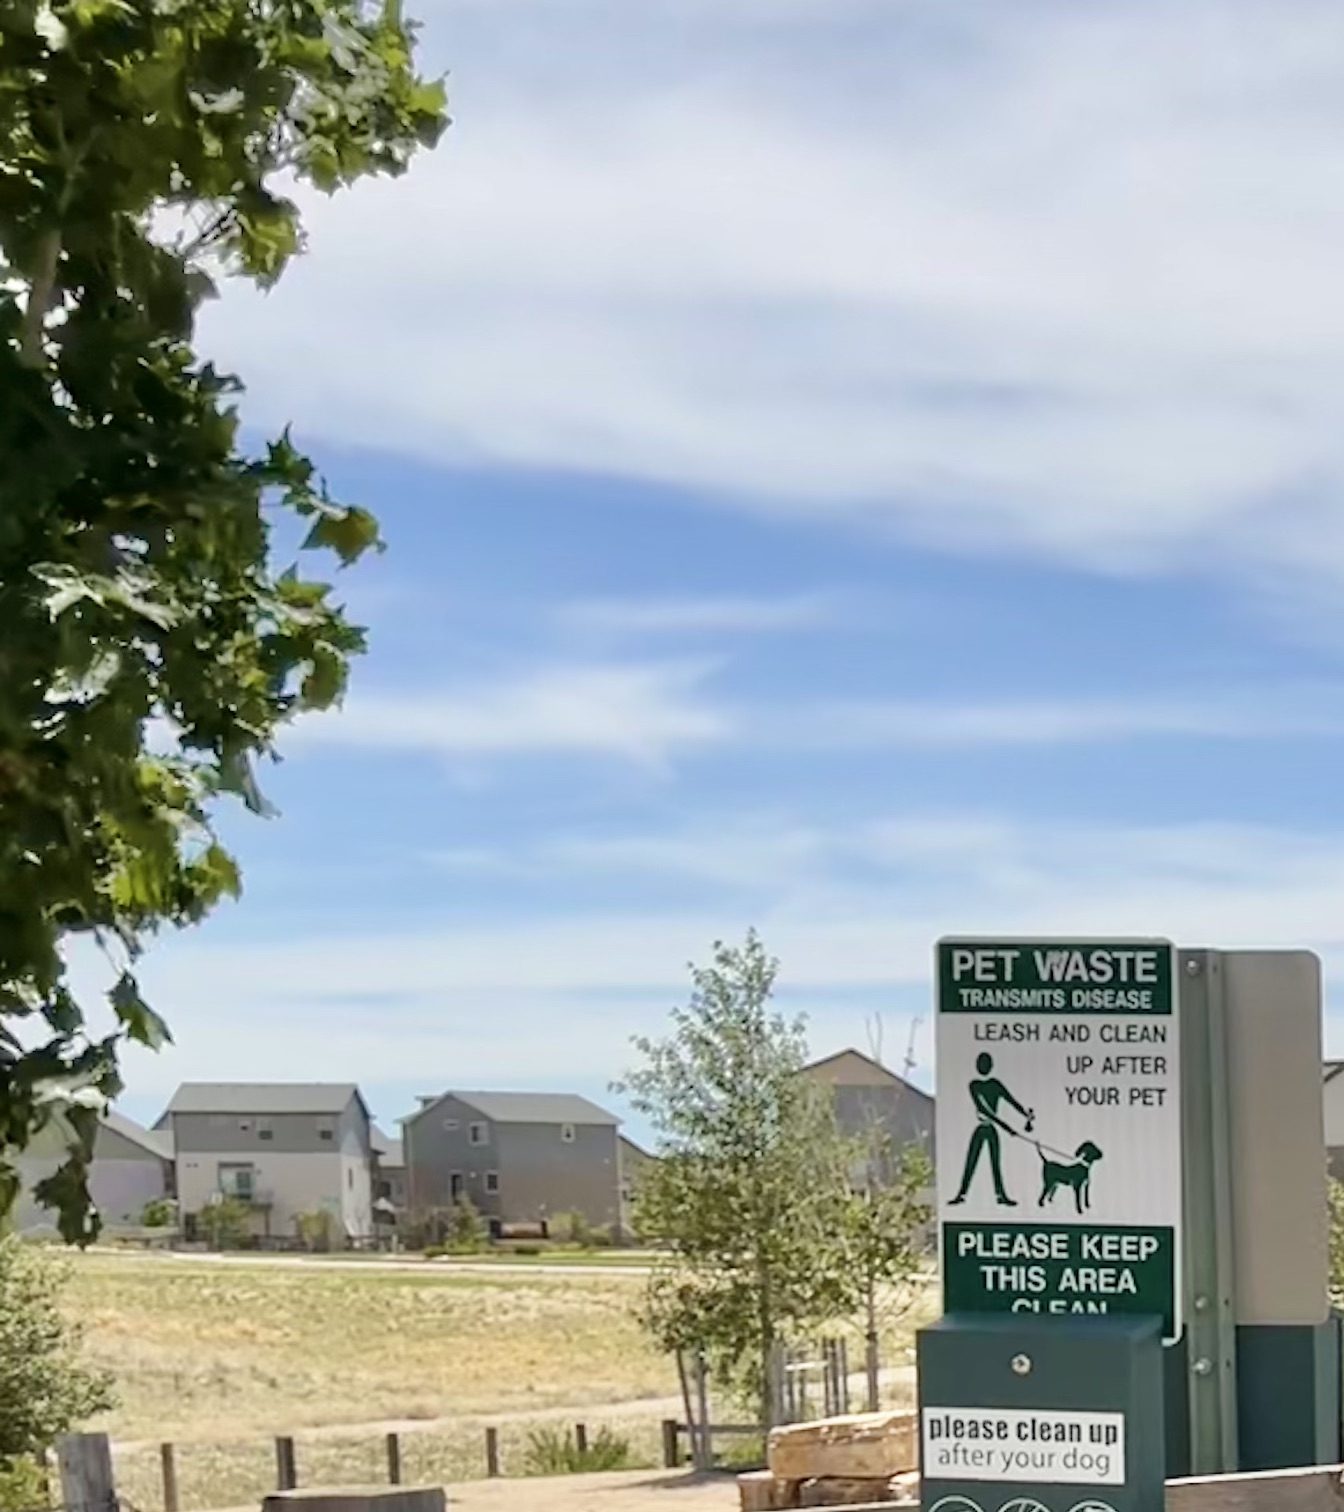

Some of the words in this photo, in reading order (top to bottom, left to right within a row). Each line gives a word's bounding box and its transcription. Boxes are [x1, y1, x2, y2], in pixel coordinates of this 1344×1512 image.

[952, 950, 1020, 982] PET
[1033, 950, 1158, 983] WASTE
[958, 987, 1066, 1008] TRANSMITS
[1071, 990, 1152, 1010] DISEASE
[974, 1023, 1040, 1042] LEASH
[1048, 1024, 1090, 1043] AND
[1099, 1024, 1167, 1044] CLEAN
[1066, 1056, 1094, 1075] UP
[1101, 1056, 1167, 1076] AFTER
[1065, 1087, 1120, 1106] YOUR
[1128, 1088, 1168, 1107] PET
[957, 1231, 1070, 1260] PLEASE
[1080, 1233, 1160, 1262] KEEP
[979, 1265, 1048, 1293] THIS
[1057, 1267, 1138, 1294] AREA
[929, 1416, 1009, 1441] please
[1016, 1418, 1082, 1443] clean
[1089, 1423, 1118, 1446] up
[938, 1442, 995, 1467] after
[1001, 1450, 1054, 1473] your
[1062, 1448, 1111, 1477] dog
